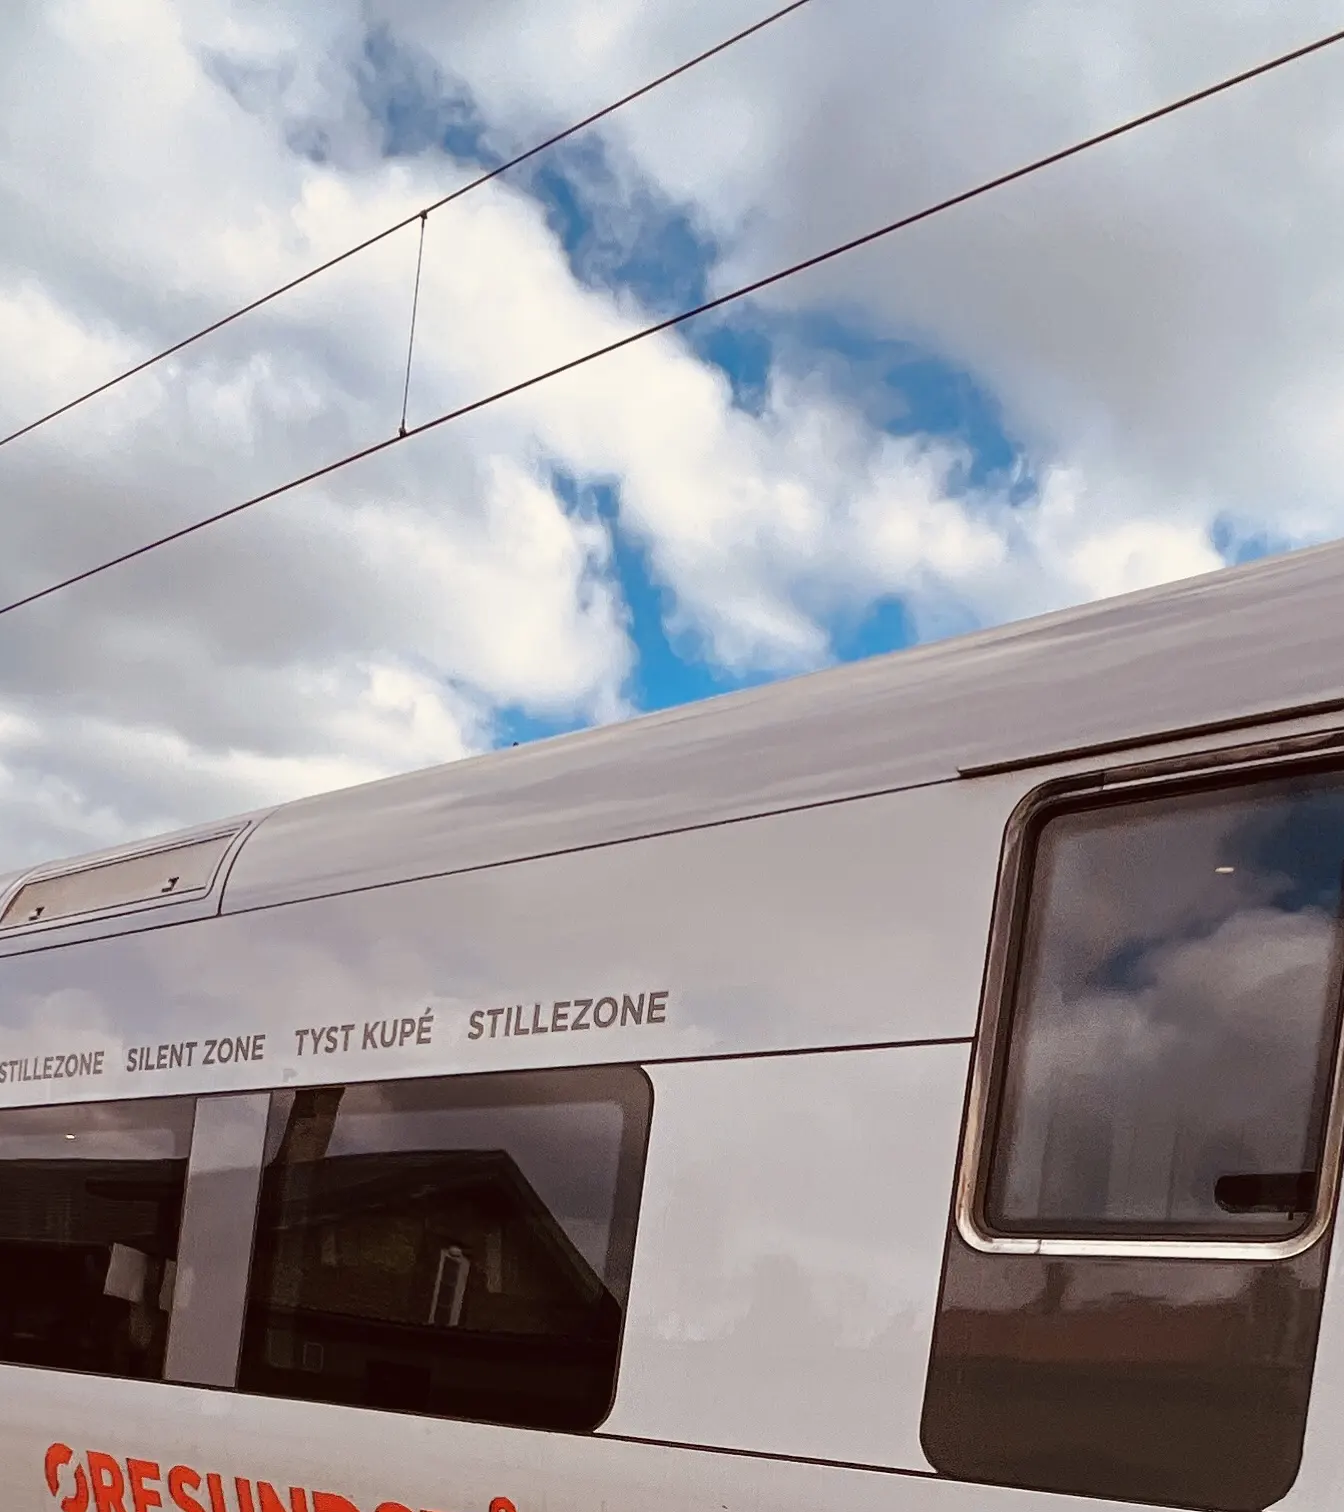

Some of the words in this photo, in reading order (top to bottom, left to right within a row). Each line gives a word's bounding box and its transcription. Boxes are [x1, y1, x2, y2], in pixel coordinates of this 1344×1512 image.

[126, 1041, 197, 1072] SILENT
[202, 1034, 266, 1065] ZONE
[295, 1024, 356, 1056] TYST
[361, 1007, 434, 1050] KUPÉ
[468, 991, 669, 1040] STILLEZONE
